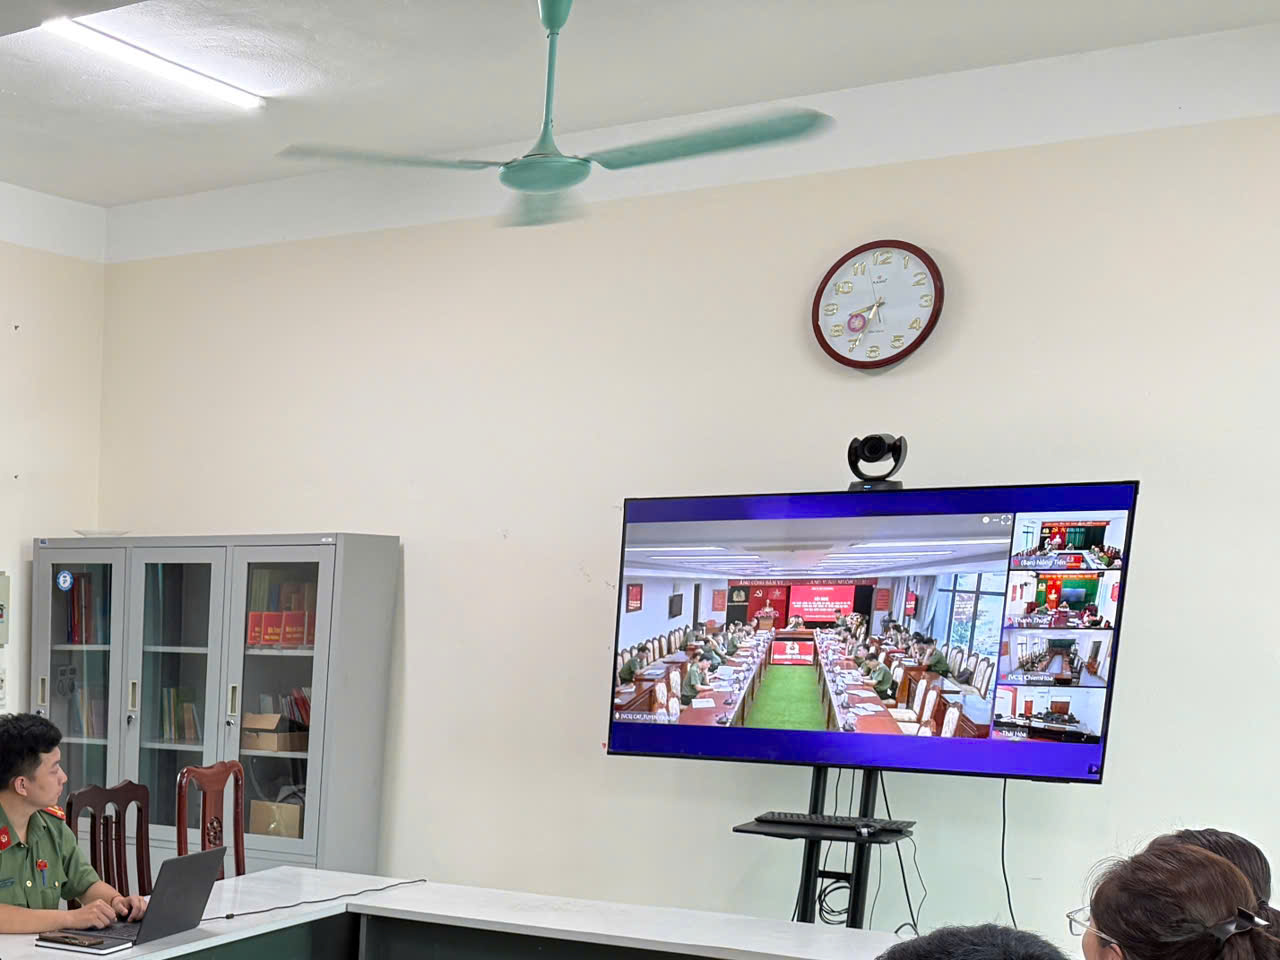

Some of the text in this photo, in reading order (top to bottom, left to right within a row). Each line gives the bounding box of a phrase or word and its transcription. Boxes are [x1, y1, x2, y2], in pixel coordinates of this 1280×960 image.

[873, 250, 893, 265] 12
[904, 255, 909, 269] 1
[853, 262, 866, 276] 11
[912, 272, 927, 286] 2
[835, 281, 853, 295] 10
[919, 294, 933, 308] 3
[824, 303, 838, 317] 9
[830, 324, 844, 337] 8
[908, 317, 922, 331] 4
[890, 335, 904, 349] 5
[866, 345, 880, 359] 6
